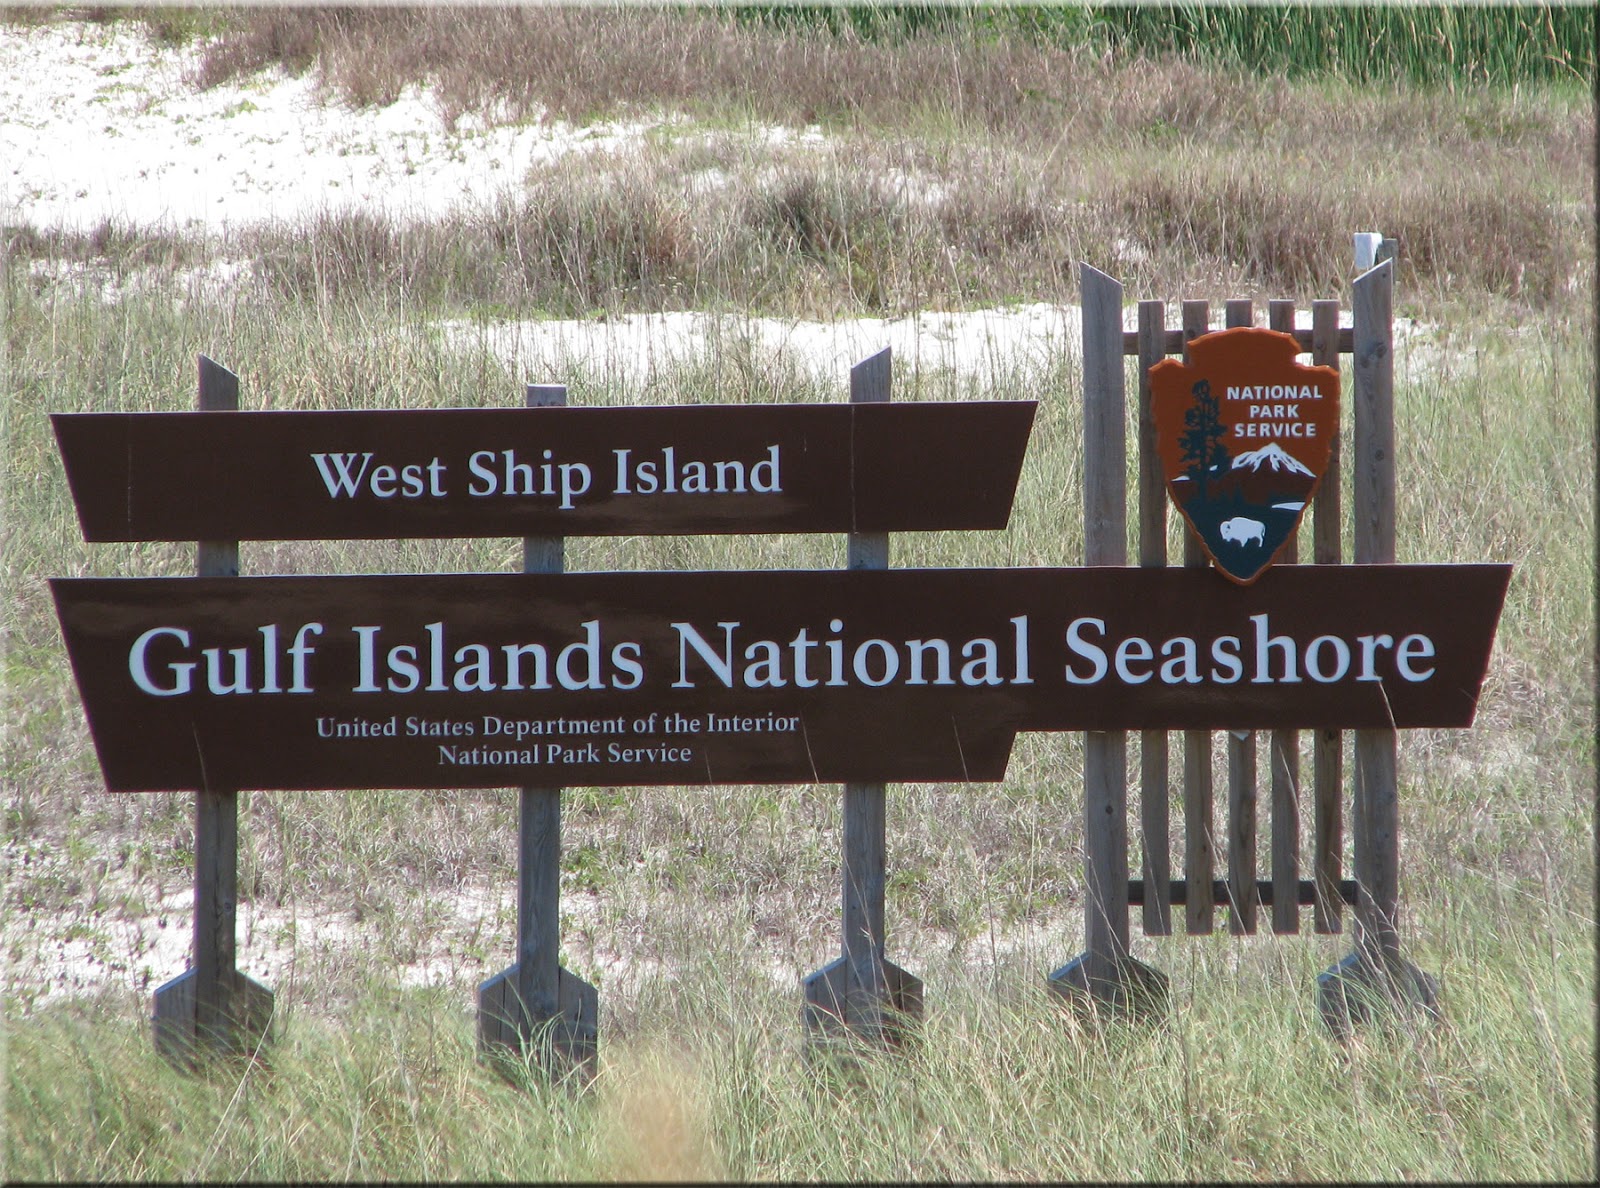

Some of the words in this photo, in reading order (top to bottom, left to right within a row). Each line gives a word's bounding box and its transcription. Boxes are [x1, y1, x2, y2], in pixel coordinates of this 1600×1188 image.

[1226, 385, 1323, 400] NATIONAL
[1249, 404, 1299, 419] PARK
[1234, 422, 1316, 438] SERVICE
[310, 451, 447, 498] West
[468, 449, 591, 510] Ship
[612, 444, 782, 494] Island
[129, 622, 323, 696] Gulf
[351, 619, 644, 693] Islands
[670, 615, 1035, 689] National
[1064, 613, 1436, 686] Seashore
[315, 715, 397, 738] United
[404, 715, 475, 737] States
[481, 715, 626, 741] Department
[632, 712, 658, 734] of
[662, 712, 702, 734] the
[706, 711, 800, 733] Interior
[438, 743, 540, 765] National
[546, 743, 600, 764] Park
[607, 742, 692, 763] Service
